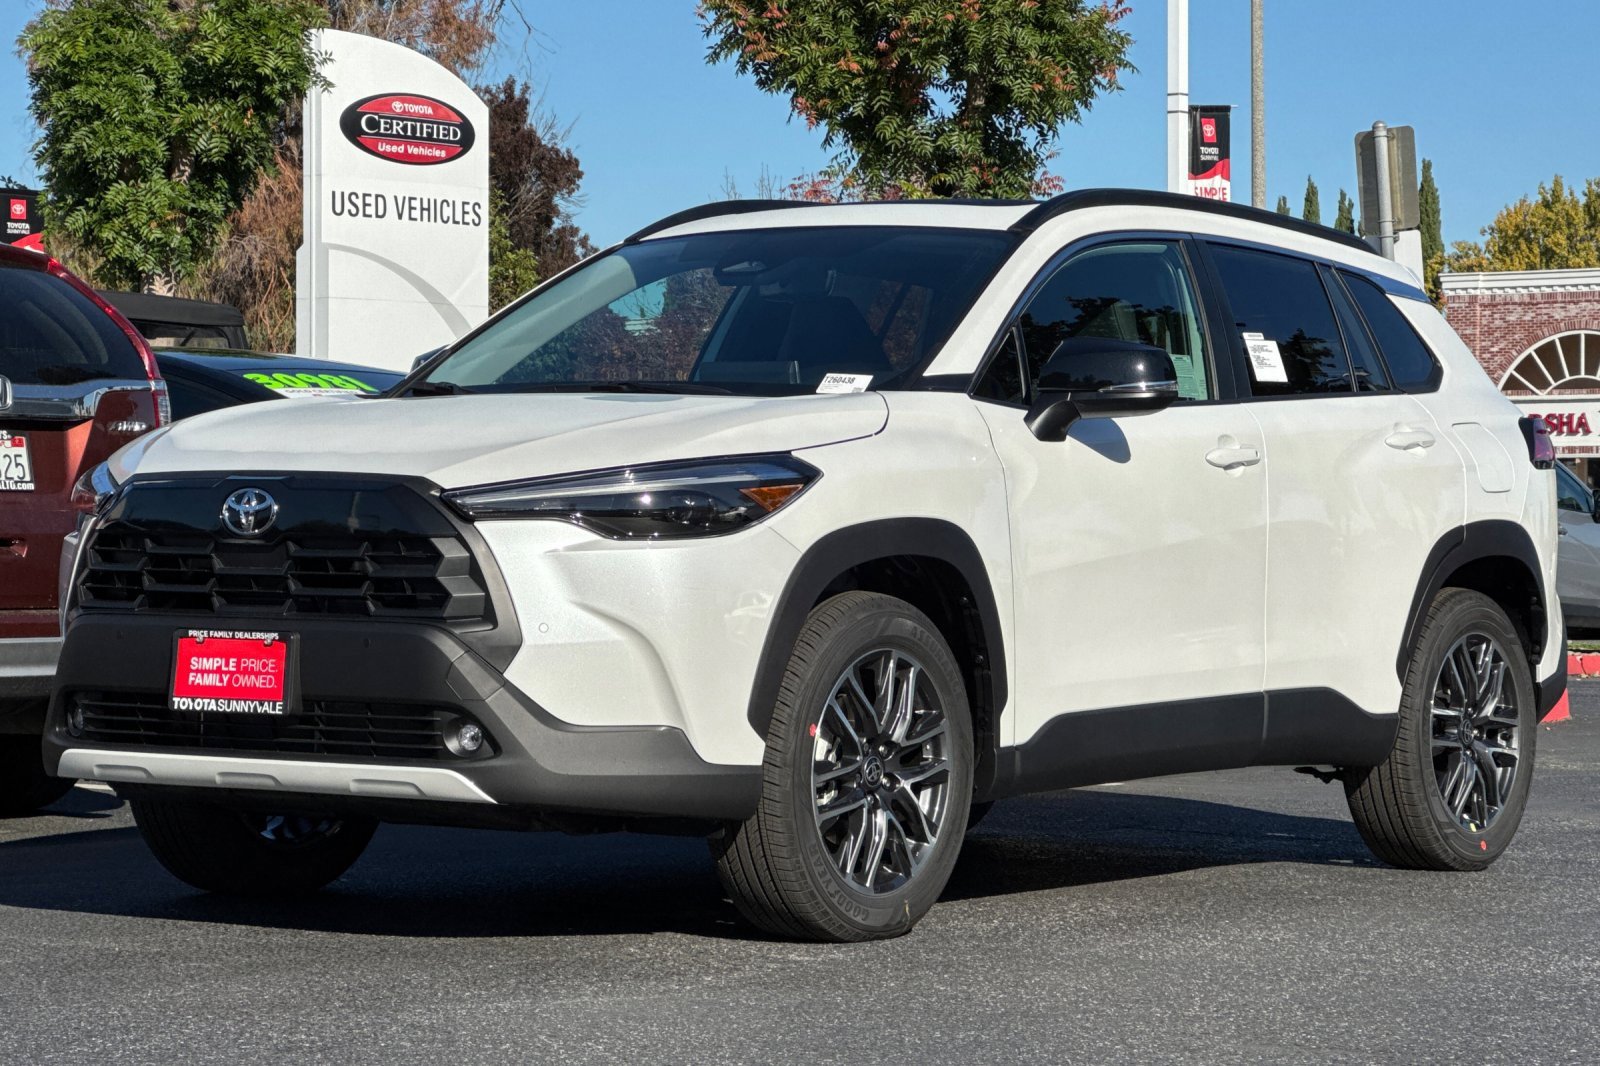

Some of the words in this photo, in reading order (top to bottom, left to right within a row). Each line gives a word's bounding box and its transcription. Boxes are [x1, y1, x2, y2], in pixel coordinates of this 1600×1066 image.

[404, 103, 433, 115] TOYOTA
[361, 113, 461, 141] CERTIFIED
[378, 142, 404, 154] Used
[407, 144, 446, 158] Vehicles
[331, 190, 387, 219] USED
[393, 195, 482, 227] VEHICLES
[824, 376, 856, 384] T260438
[0, 454, 26, 481] 25
[0, 480, 35, 491] LTO.com
[188, 629, 208, 639] PRICE
[209, 630, 233, 640] FAMILY
[234, 631, 279, 641] DEALERSHIPS
[190, 656, 237, 672] SIMPLE
[240, 658, 278, 673] PRICE.
[188, 672, 230, 687] FAMILY
[232, 674, 277, 688] OWNED.
